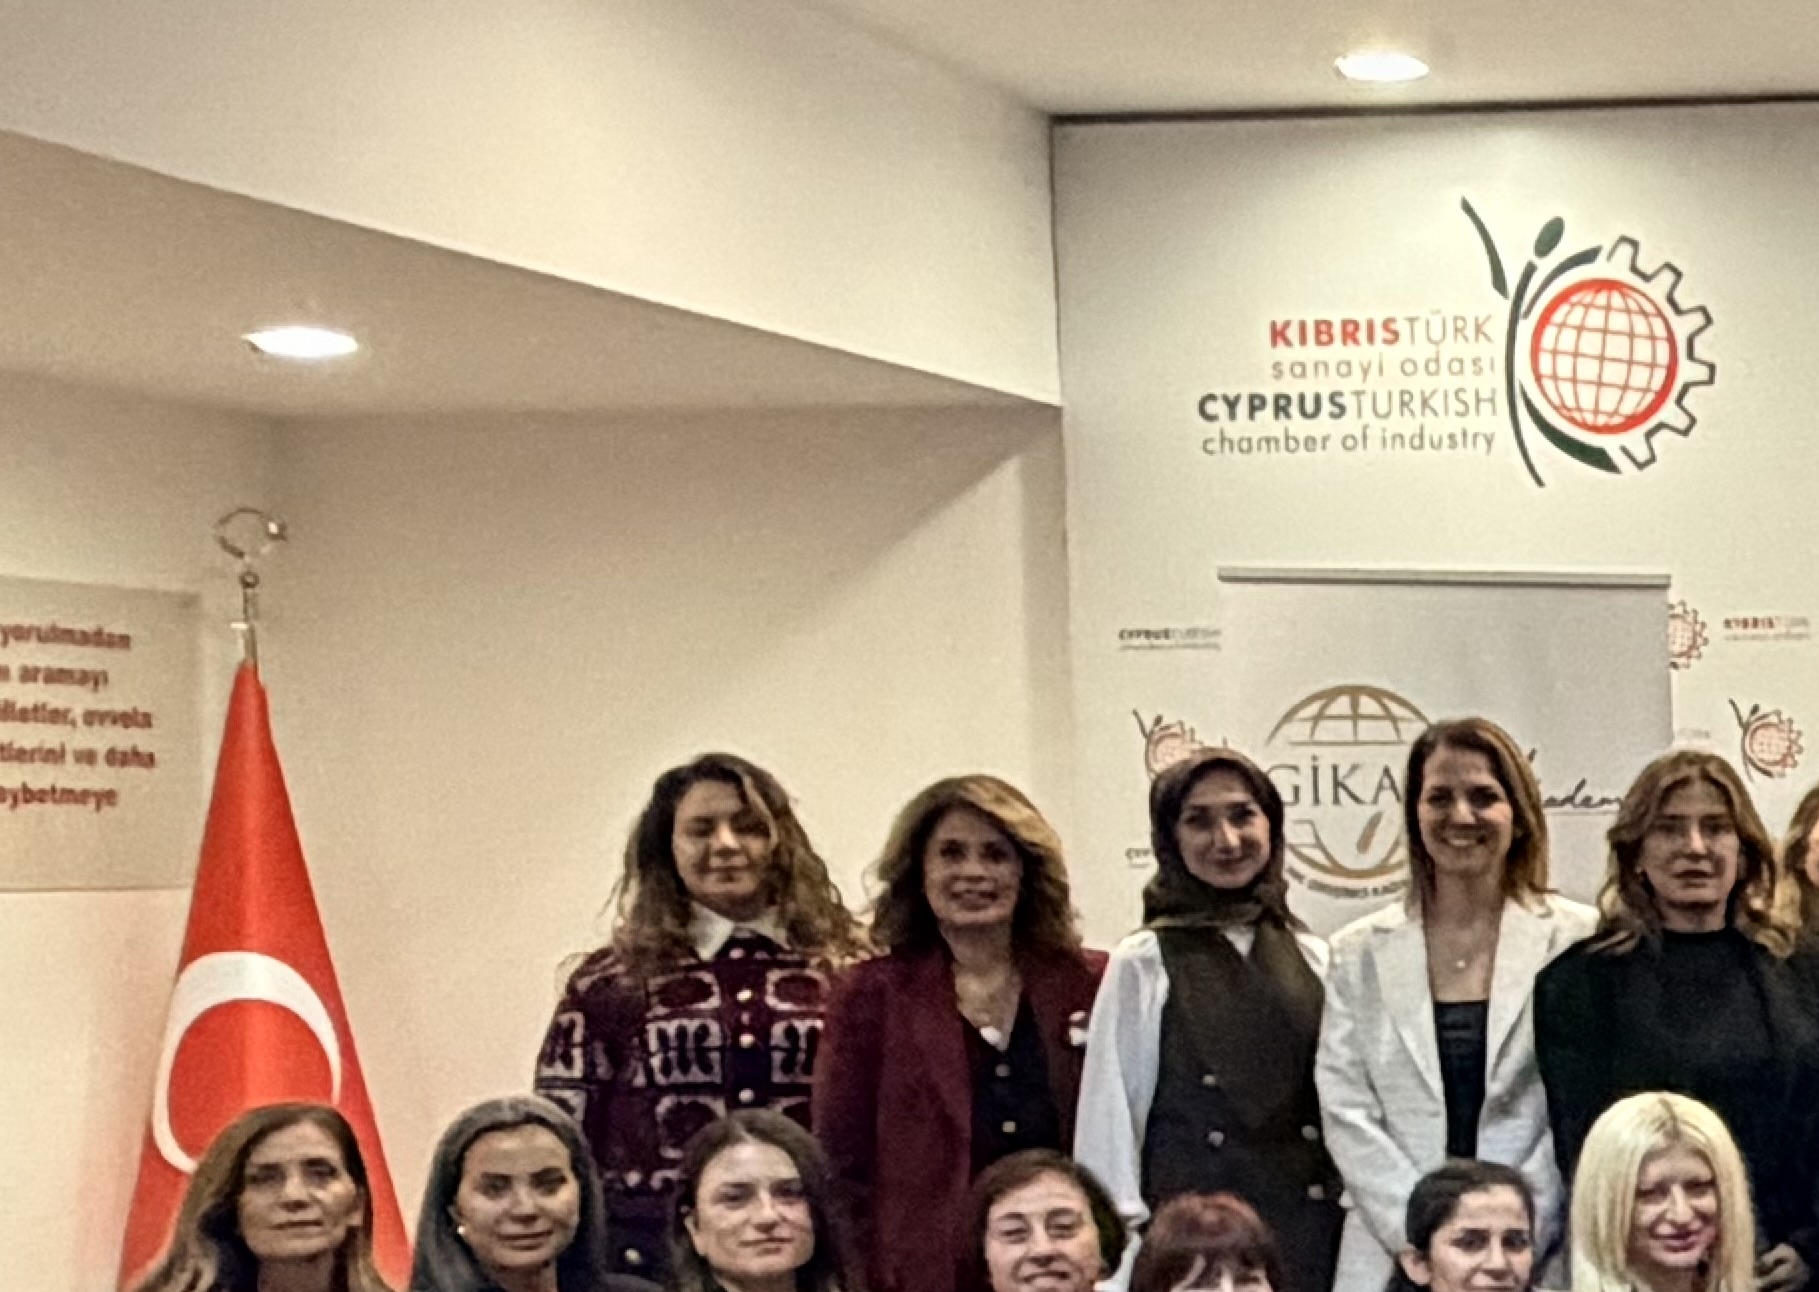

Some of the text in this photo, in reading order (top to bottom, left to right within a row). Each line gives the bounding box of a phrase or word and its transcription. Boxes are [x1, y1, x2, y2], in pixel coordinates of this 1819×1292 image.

[1269, 308, 1494, 348] KIBRISTÜRK
[1271, 344, 1496, 383] sanayi odası
[1198, 388, 1498, 422] CYPRUSTURKISH
[1202, 423, 1496, 456] chamber of industry
[1264, 755, 1402, 806] GİKA
